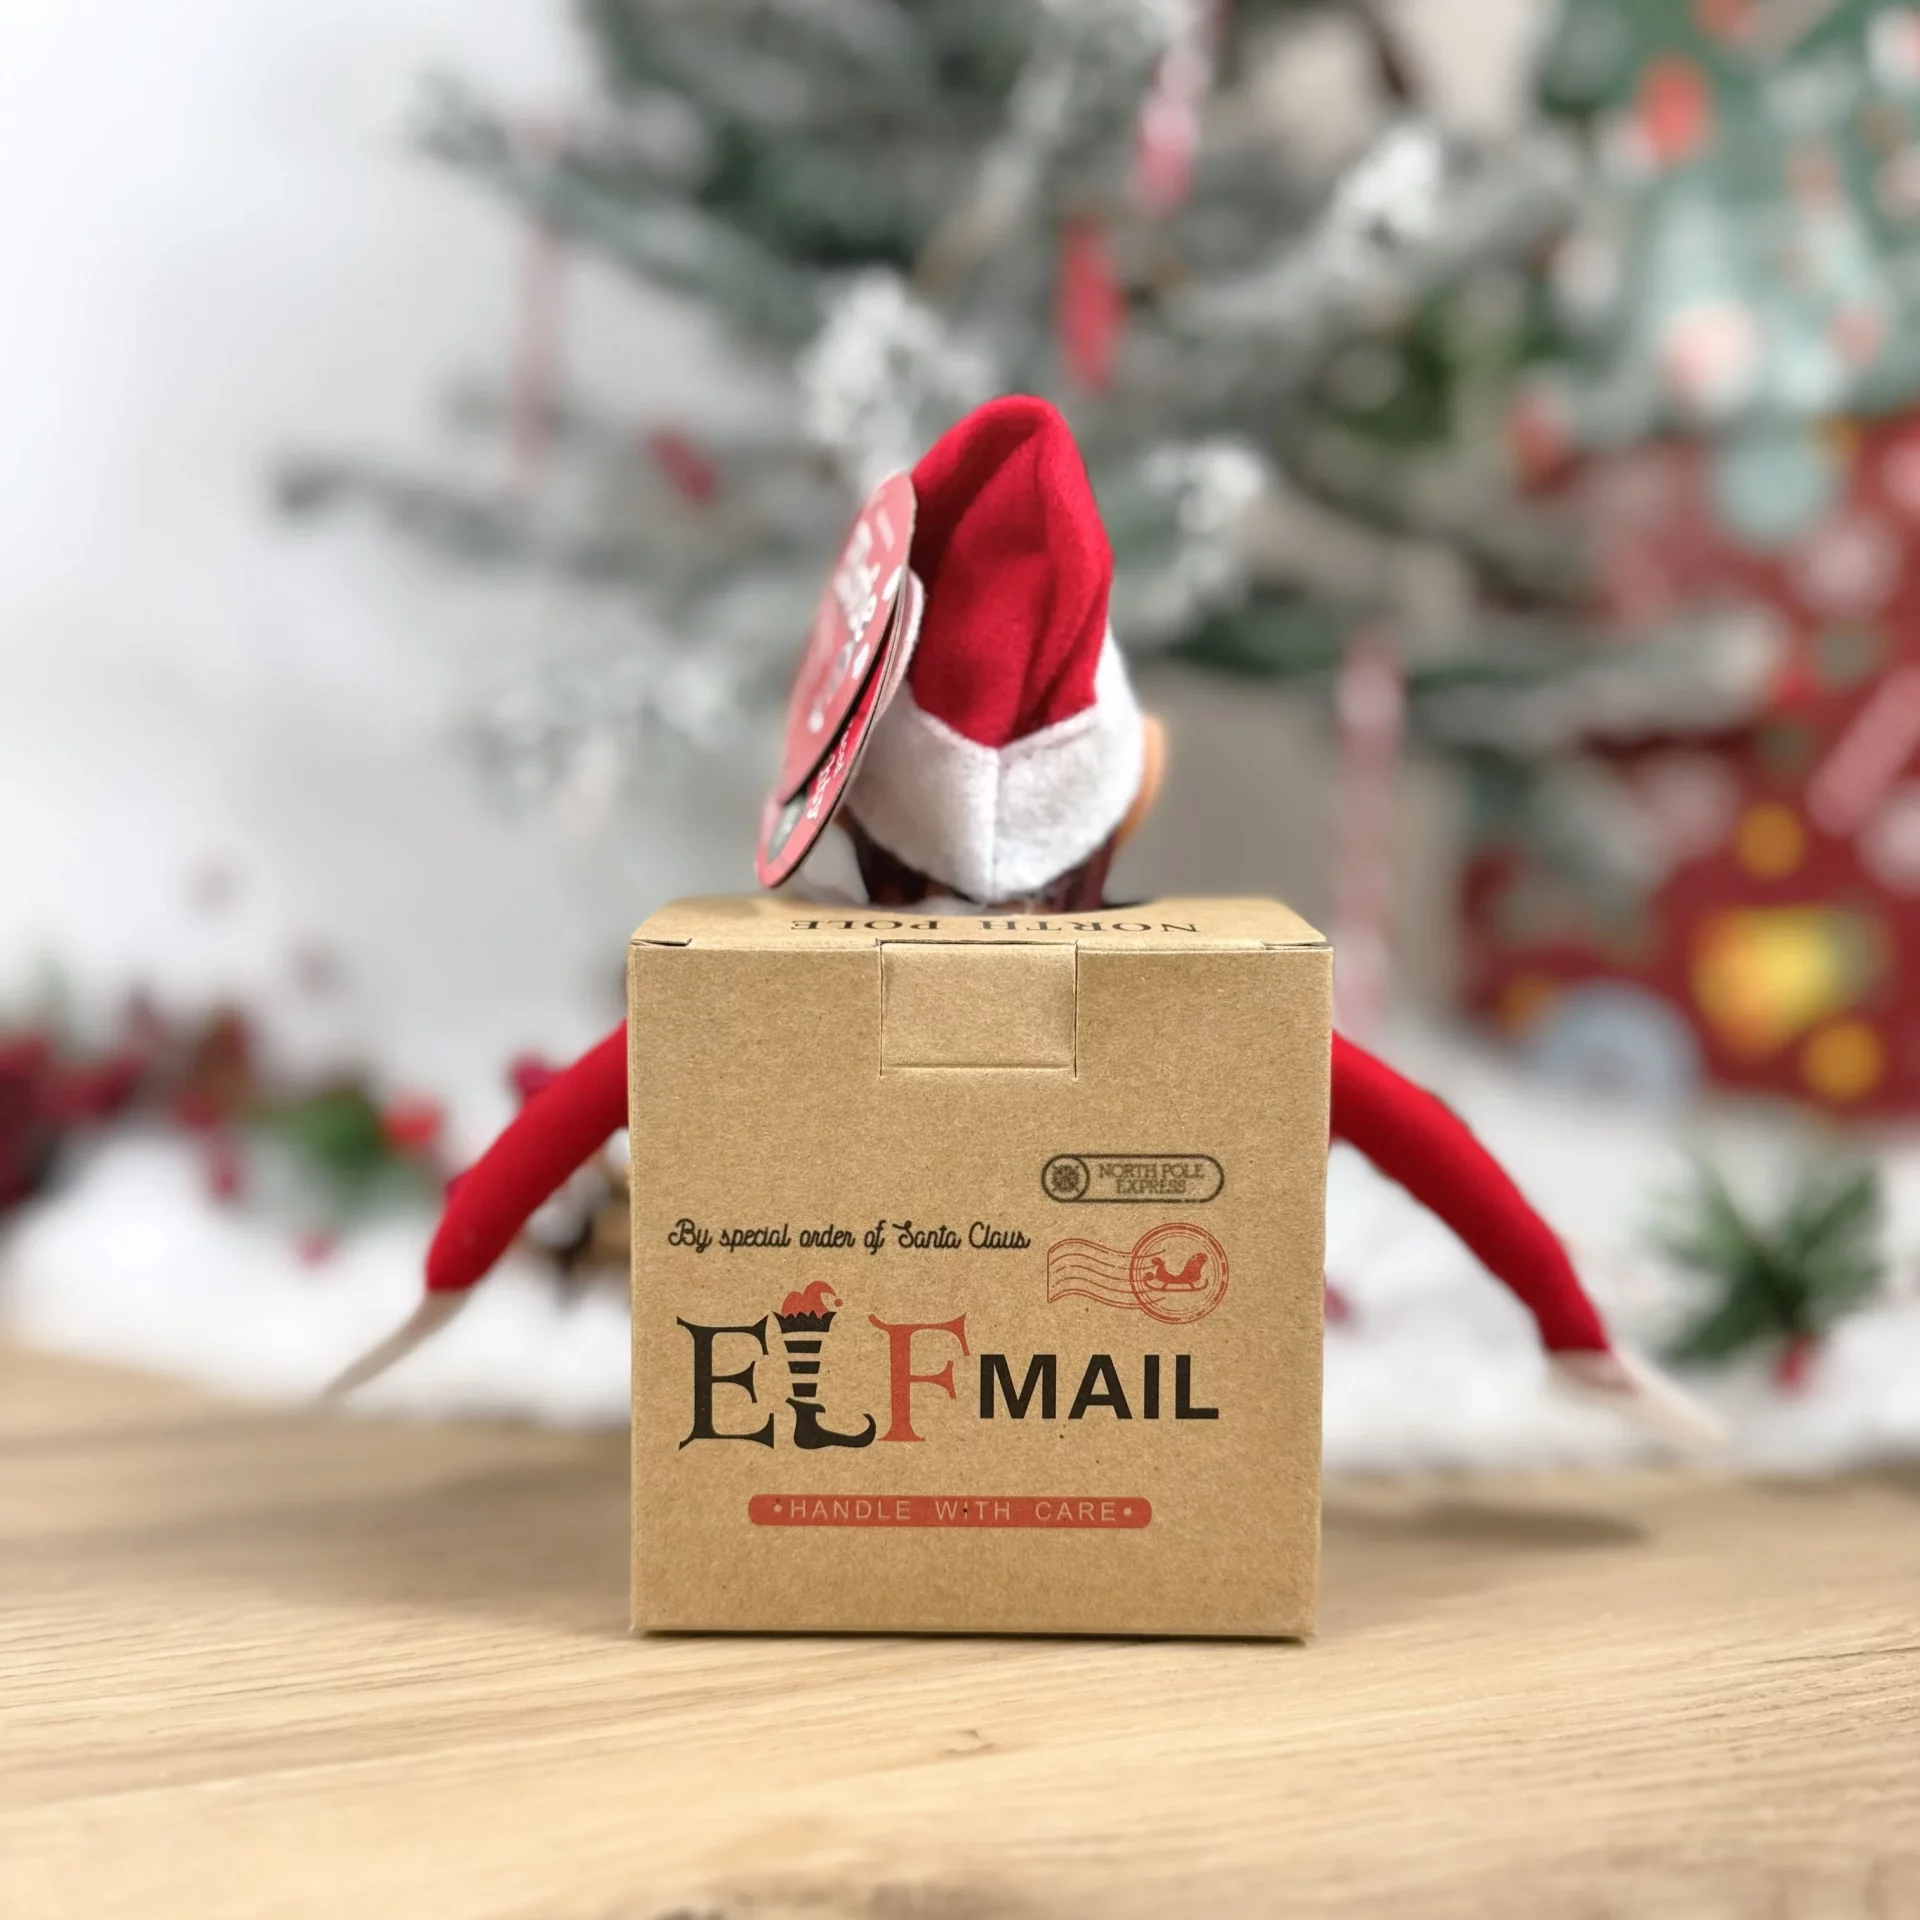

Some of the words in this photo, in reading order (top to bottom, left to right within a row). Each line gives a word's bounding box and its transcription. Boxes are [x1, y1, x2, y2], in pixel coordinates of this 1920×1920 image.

[790, 920, 940, 930] POLE
[977, 920, 1199, 933] NORTH
[1099, 1163, 1156, 1179] NORTH
[1161, 1163, 1204, 1179] POLE
[1116, 1179, 1186, 1194] EXPRESS
[668, 1218, 712, 1253] By
[719, 1224, 792, 1252] special
[799, 1224, 856, 1248] order
[864, 1219, 886, 1255] of
[892, 1220, 962, 1249] Santa
[968, 1221, 1031, 1249] Claus
[677, 1312, 971, 1450] ELF
[979, 1354, 1219, 1419] MAIL
[788, 1500, 911, 1520] HANDLE
[935, 1501, 1012, 1522] WITH
[1034, 1502, 1119, 1523] CARE
